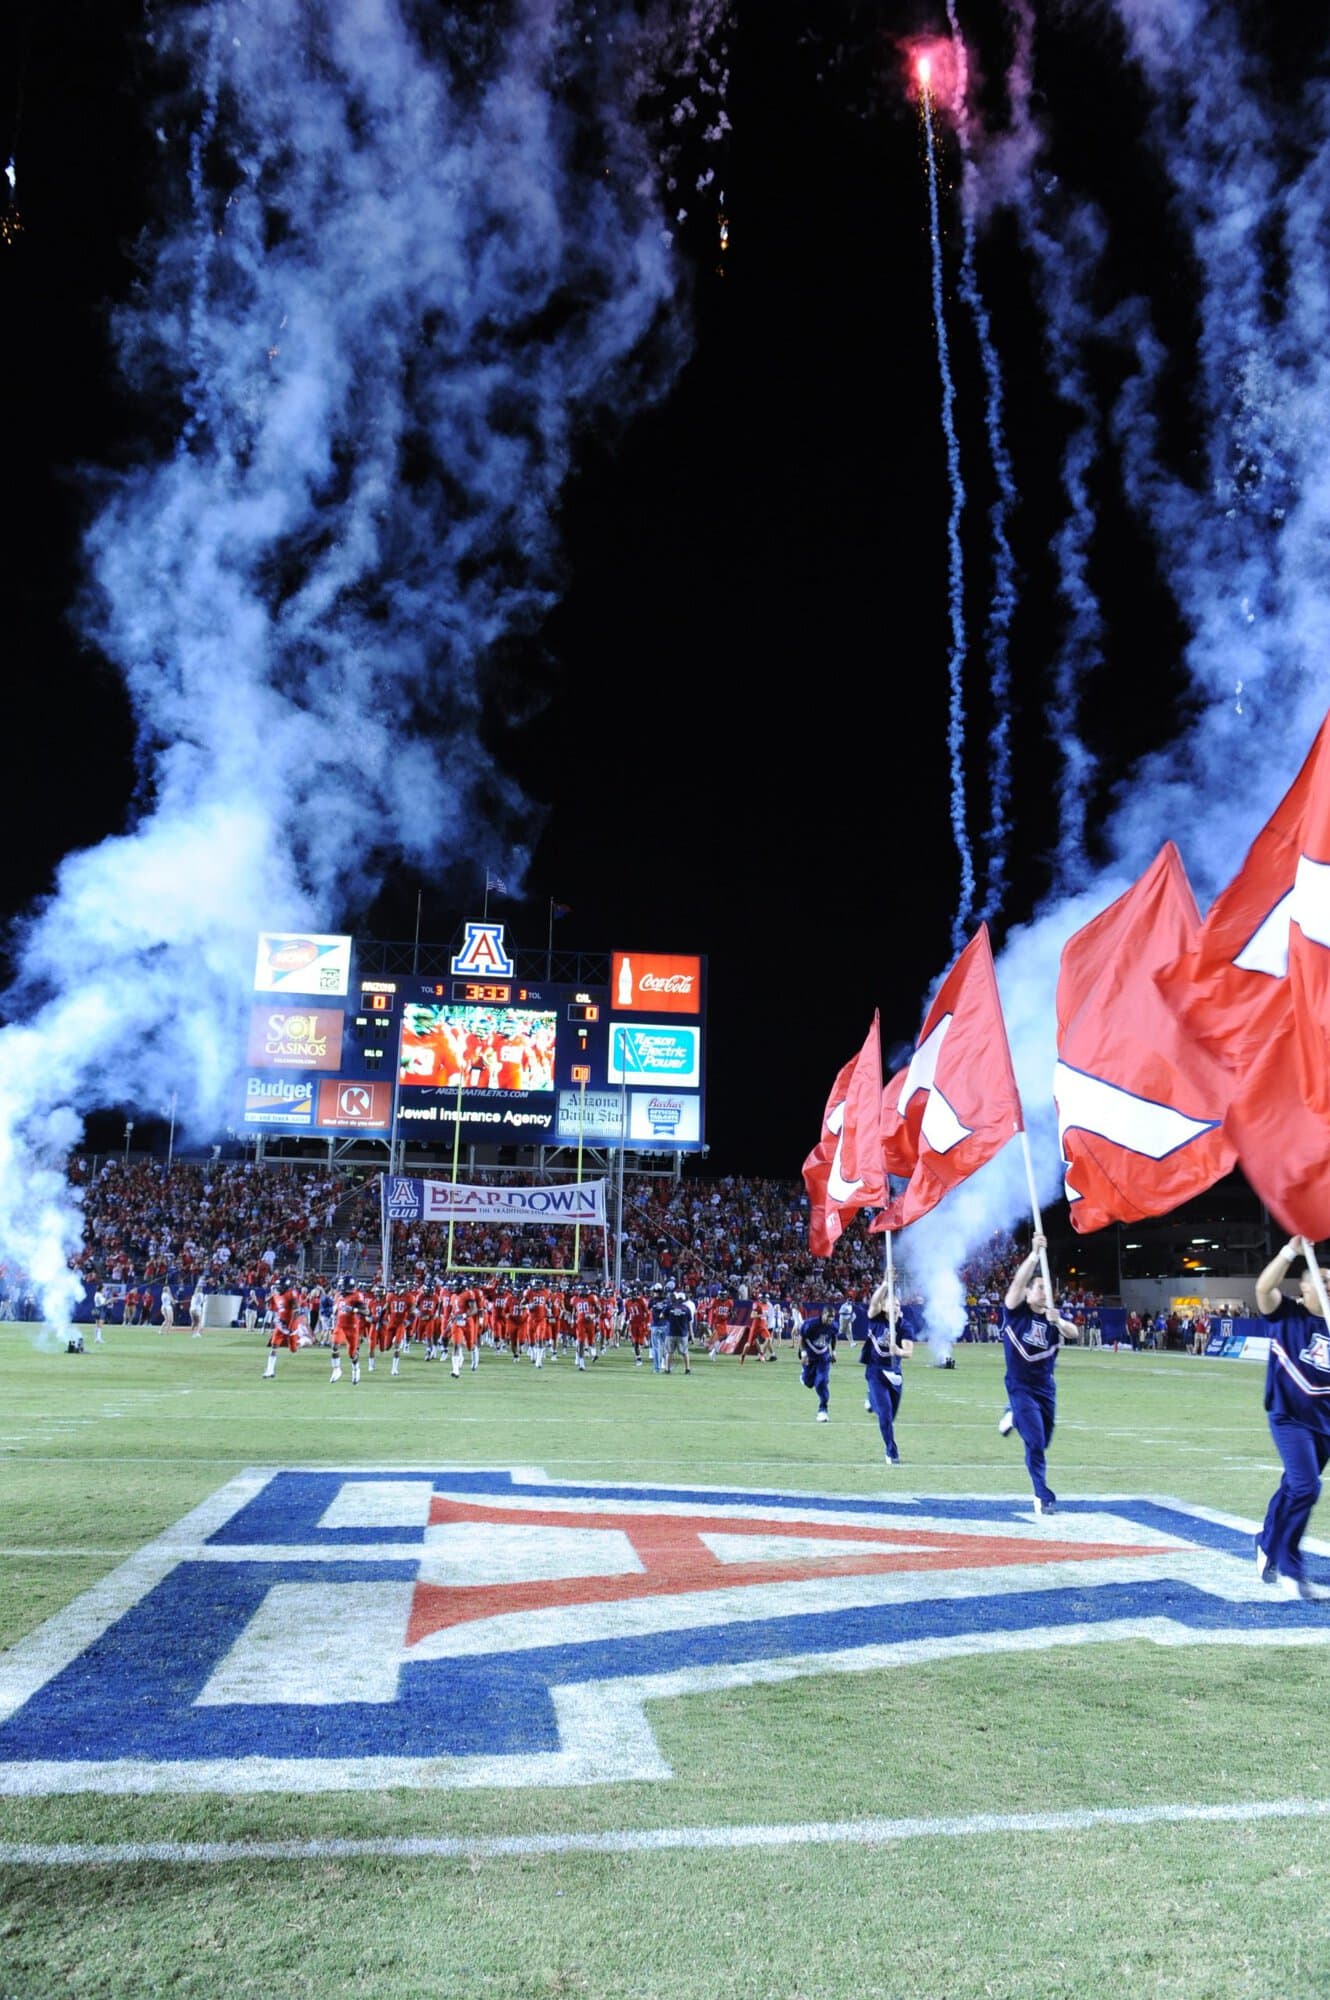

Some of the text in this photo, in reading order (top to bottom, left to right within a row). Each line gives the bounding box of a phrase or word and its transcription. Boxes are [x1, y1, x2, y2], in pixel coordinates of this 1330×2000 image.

[451, 922, 514, 978] A
[435, 985, 443, 995] 3
[639, 973, 694, 993] Coca-Cola
[465, 984, 510, 1002] 3:33
[519, 989, 541, 1000] 3 TOL
[373, 995, 386, 1010] 0
[585, 1006, 597, 1020] 0
[266, 1014, 327, 1043] SOL
[634, 1032, 676, 1046] Tucson
[264, 1041, 327, 1057] CASINOS
[637, 1046, 688, 1058] Electric
[643, 1057, 688, 1069] Power
[247, 1077, 313, 1101] Budget
[397, 1105, 552, 1128] Jewell Insurance Agency
[431, 1186, 596, 1212] BEAR DOWN
[388, 1207, 418, 1218] CLUB
